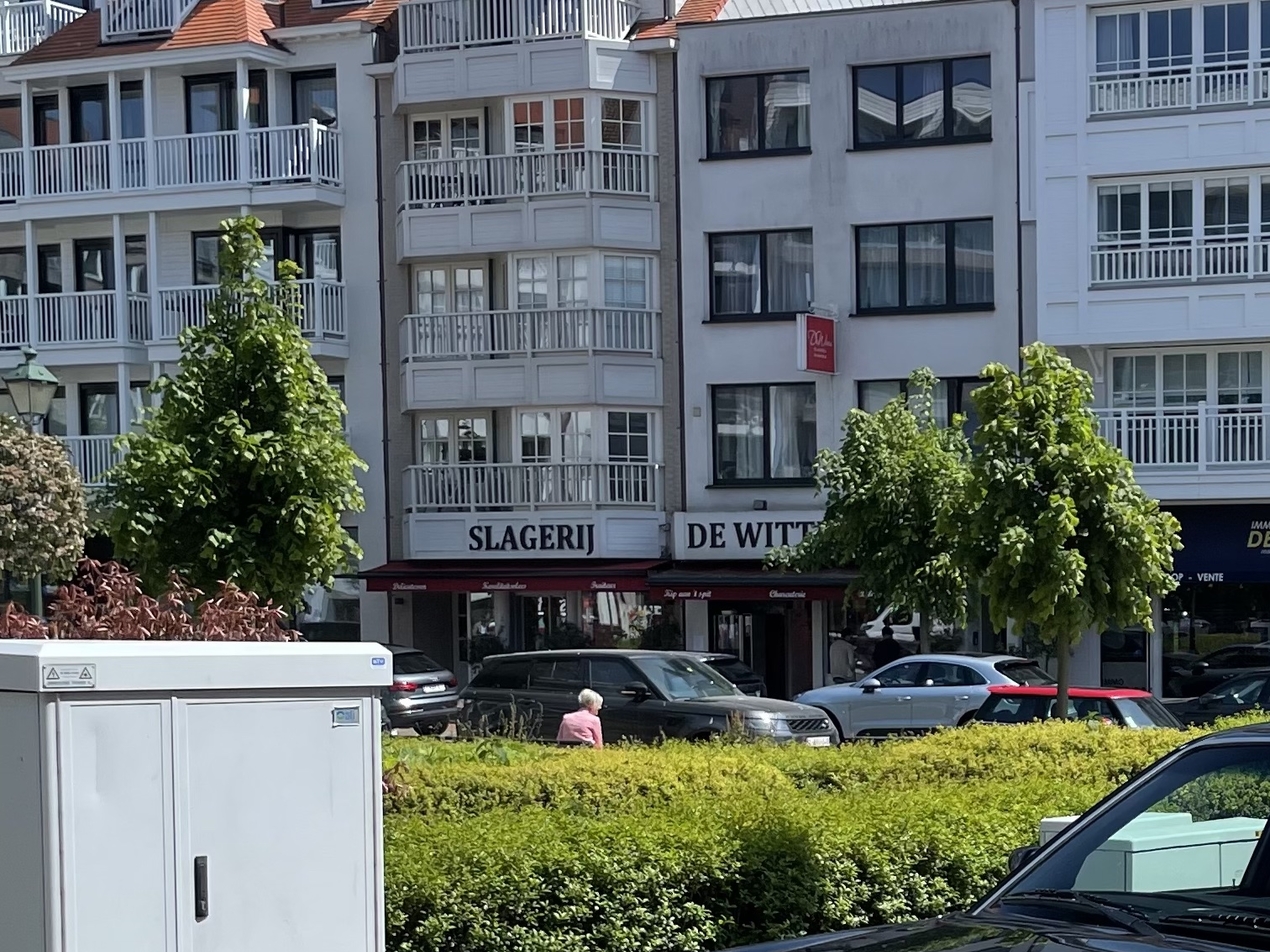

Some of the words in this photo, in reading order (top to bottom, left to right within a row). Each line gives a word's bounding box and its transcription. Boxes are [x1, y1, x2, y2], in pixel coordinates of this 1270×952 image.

[469, 524, 595, 555] SLAGERIJ
[687, 522, 726, 549] DE
[733, 521, 822, 548] WITT
[1197, 572, 1224, 582] VENTE
